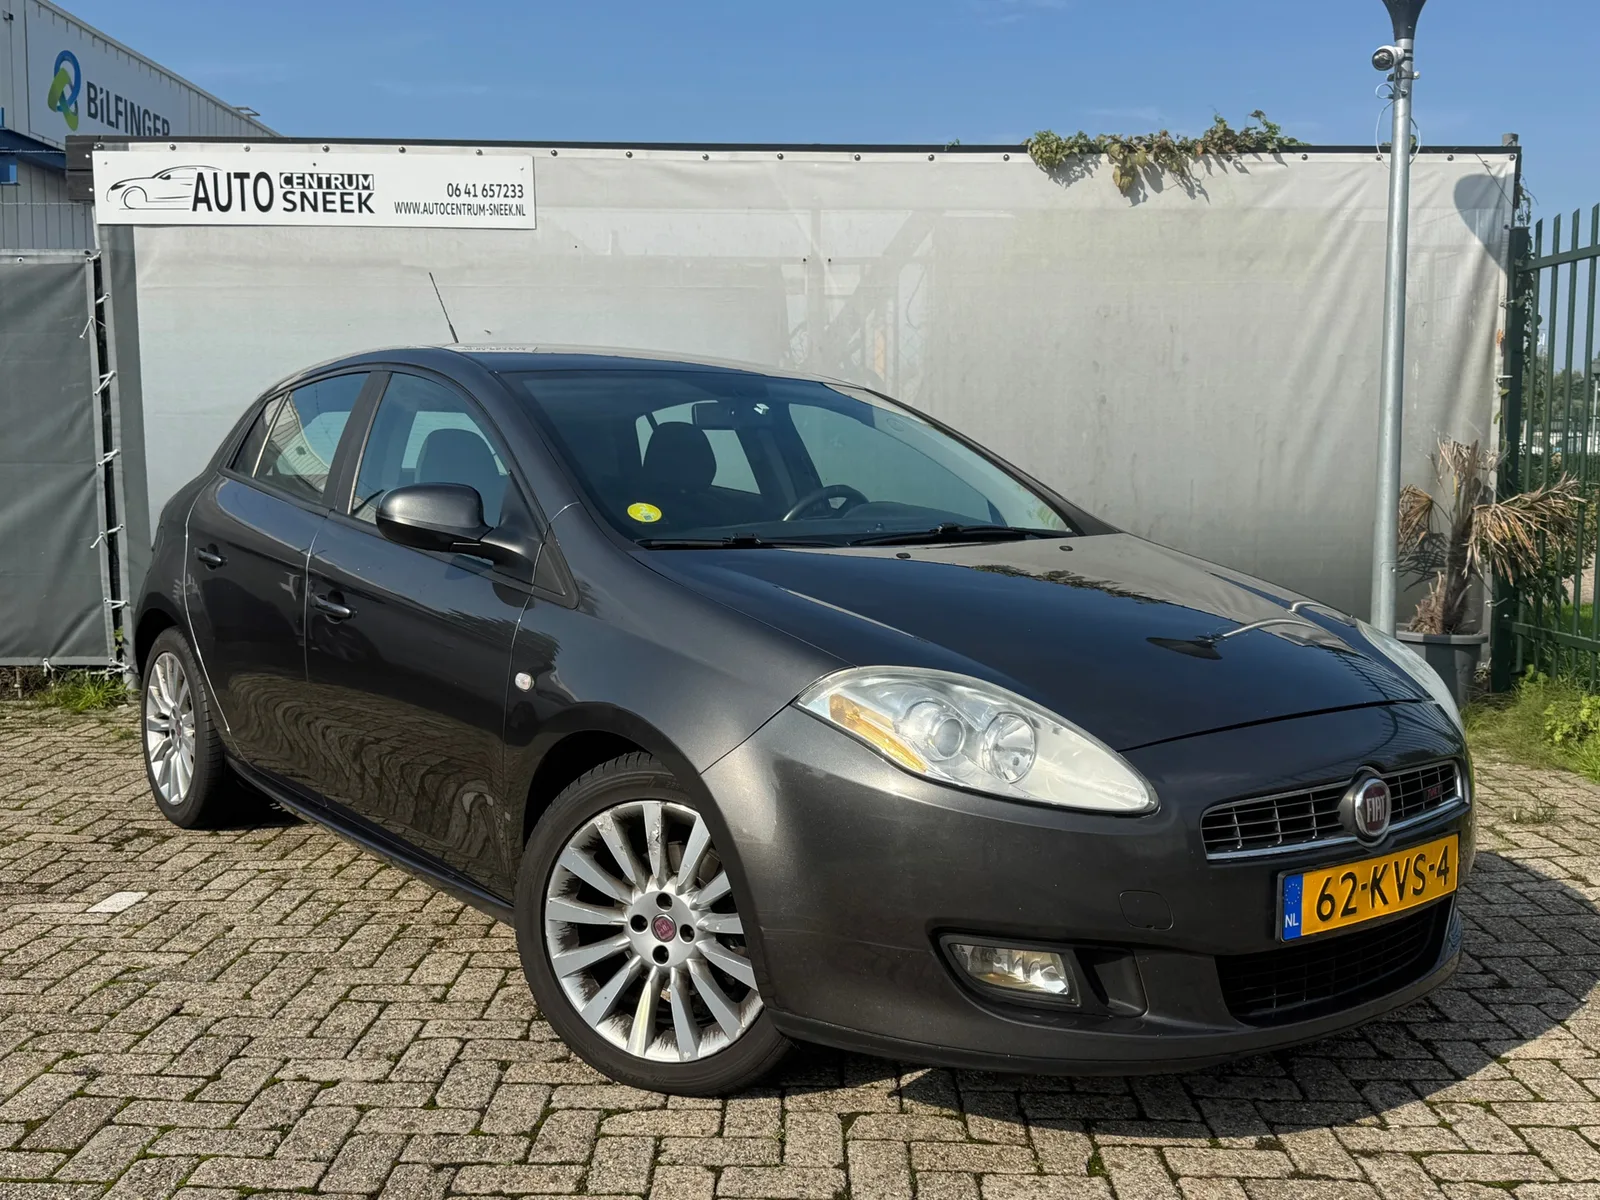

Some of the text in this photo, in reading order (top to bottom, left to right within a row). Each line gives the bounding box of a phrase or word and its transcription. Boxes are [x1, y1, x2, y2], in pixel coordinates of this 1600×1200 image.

[192, 171, 274, 212] AUTO
[280, 173, 374, 190] CENTRUM
[447, 183, 524, 198] 06 41 657233
[282, 191, 375, 213] SNEEK
[394, 201, 526, 216] WWW.AUTOCENTRUM-SNEEK.NL
[1366, 795, 1385, 822] FIAT
[1285, 845, 1449, 928] NL 62-KVS-4
